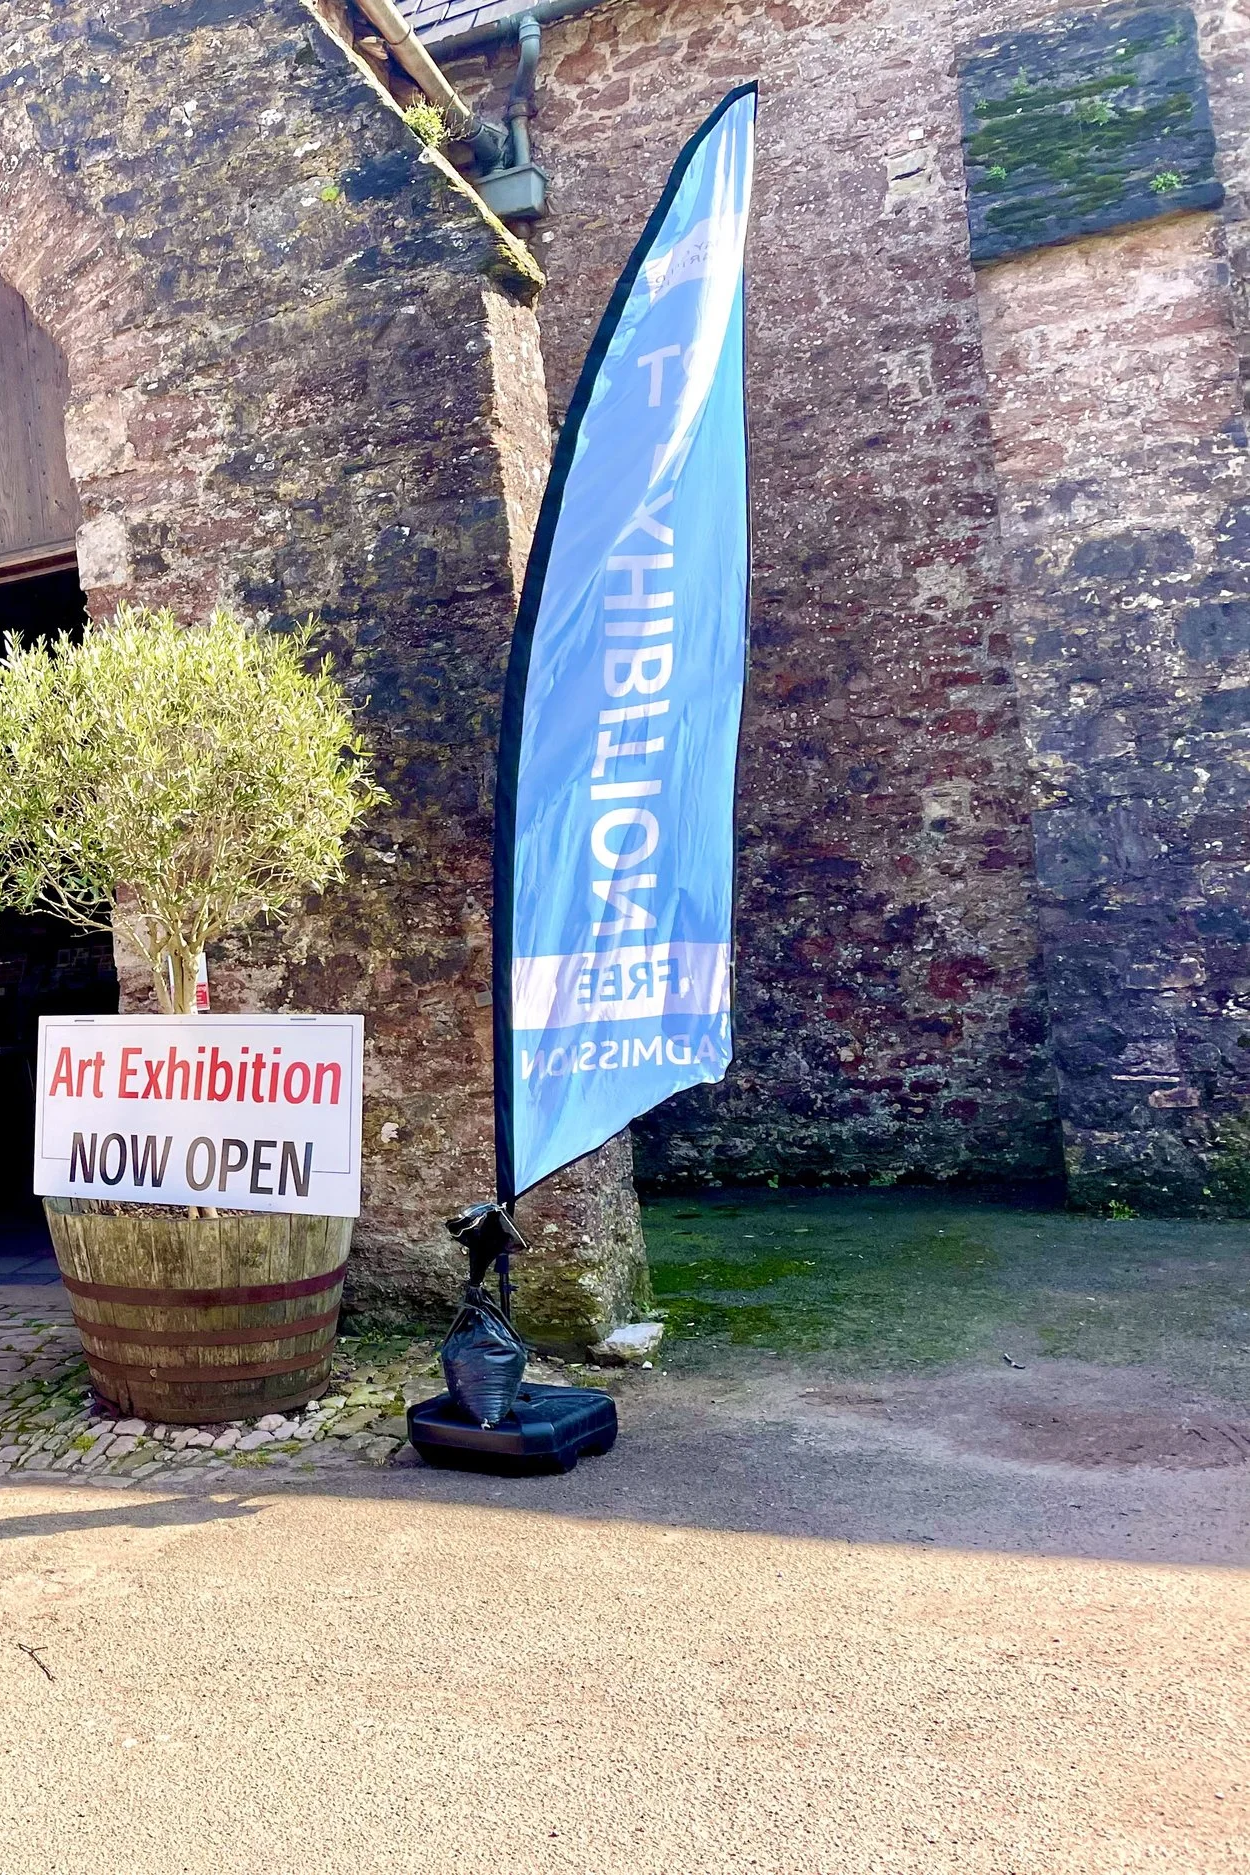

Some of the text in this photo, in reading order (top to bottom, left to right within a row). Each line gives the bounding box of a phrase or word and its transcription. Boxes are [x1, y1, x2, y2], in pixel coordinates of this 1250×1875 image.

[49, 1047, 342, 1105] Art Exhibition
[69, 1132, 314, 1197] NOW OPEN
